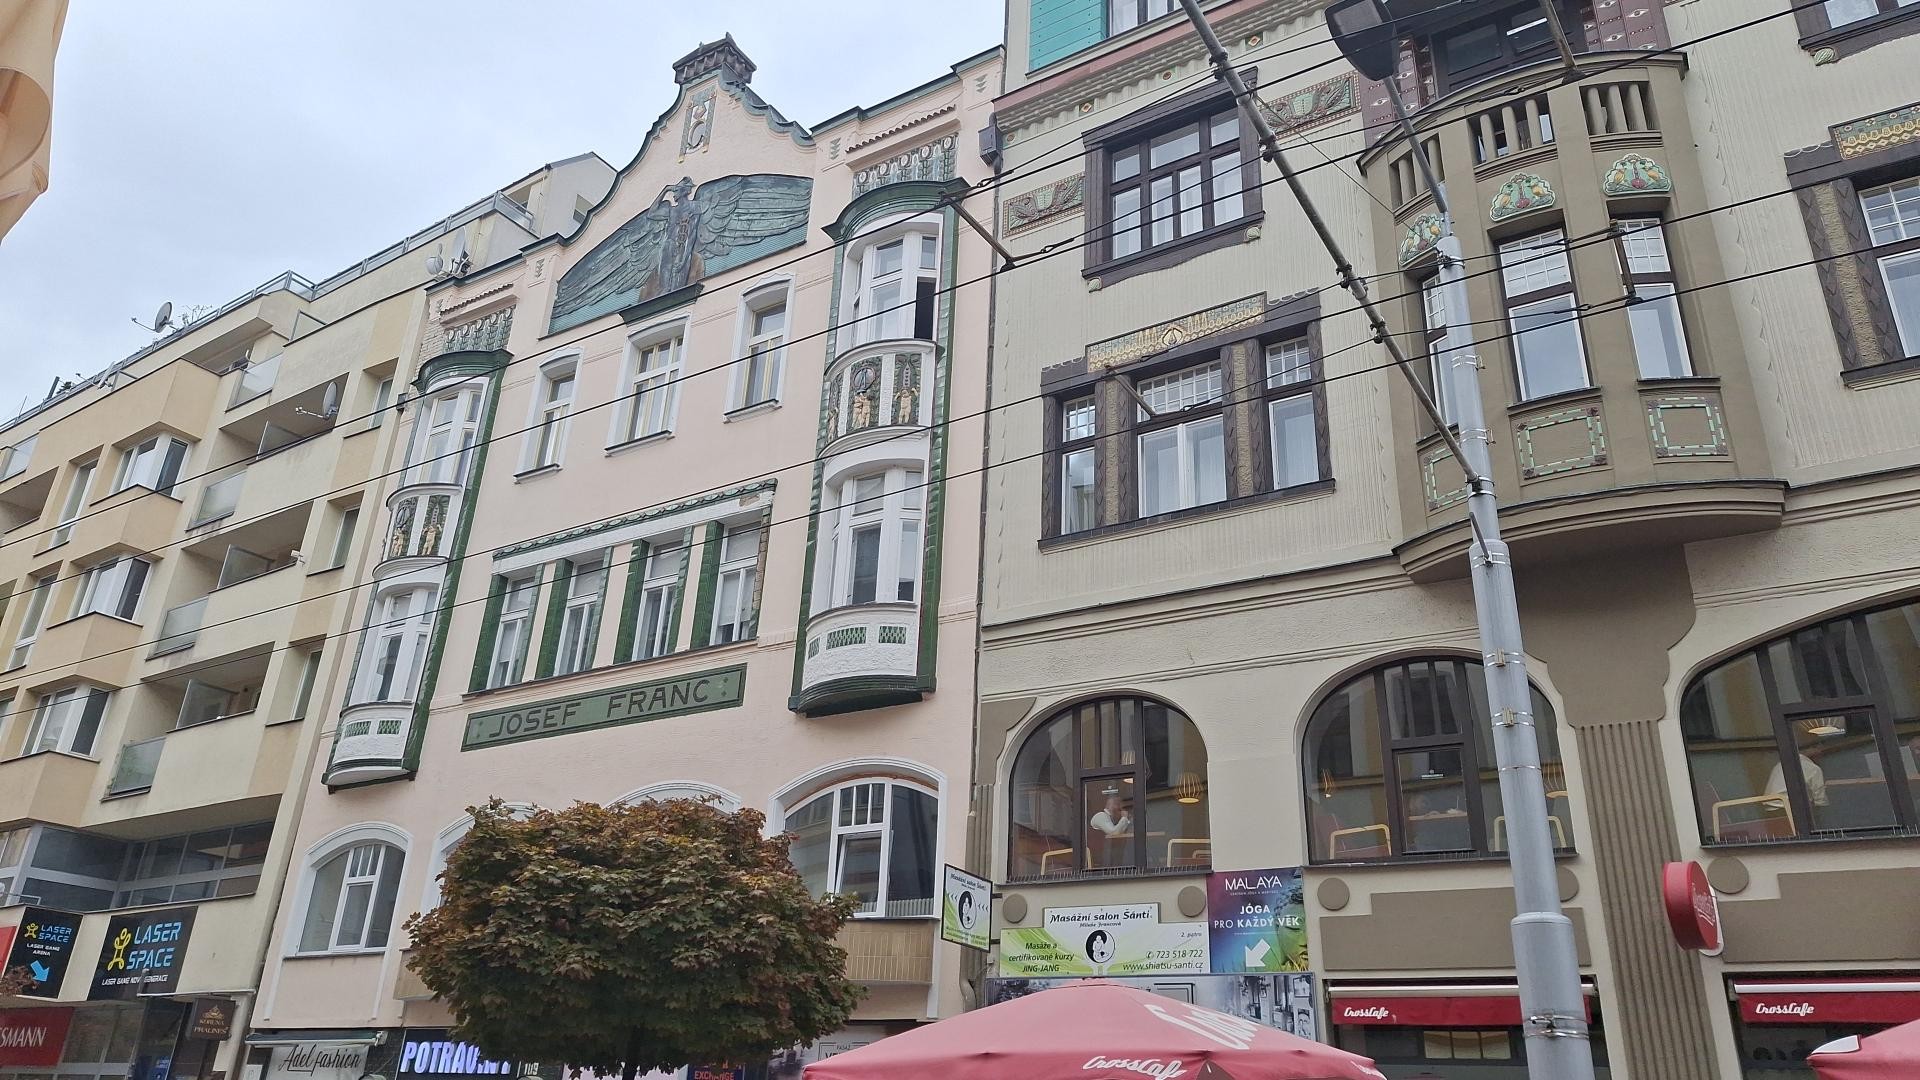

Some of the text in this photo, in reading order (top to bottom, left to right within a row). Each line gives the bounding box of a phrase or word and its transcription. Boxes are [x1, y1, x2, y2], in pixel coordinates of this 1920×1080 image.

[489, 680, 710, 738] JOSEF FRANC
[1225, 876, 1282, 890] MALAYA
[1240, 902, 1271, 915] JÓGA
[1049, 908, 1150, 924] Masážní salon Šánti
[1214, 914, 1300, 929] PRO KAŽDÝ VĚK
[41, 924, 72, 935] LASER
[134, 922, 182, 945] LASER
[38, 932, 70, 943] SPACE
[1025, 942, 1052, 950] Masáže
[126, 947, 176, 970] SPACE
[1008, 952, 1075, 962] certifikované kurzy
[1156, 949, 1204, 959] 723 518 722
[1022, 964, 1061, 973] JING-JANG
[1122, 960, 1204, 971] www.shiatsu-santi.cz
[101, 978, 117, 986] LASER
[116, 977, 130, 985] GAME
[130, 976, 144, 984] NOV
[1343, 1006, 1389, 1020] CrossCafe
[1755, 1002, 1814, 1017] CrossCafe
[0, 1026, 47, 1048] SMANN
[278, 1043, 361, 1077] Adel fashion
[400, 1041, 511, 1075] POTRAV
